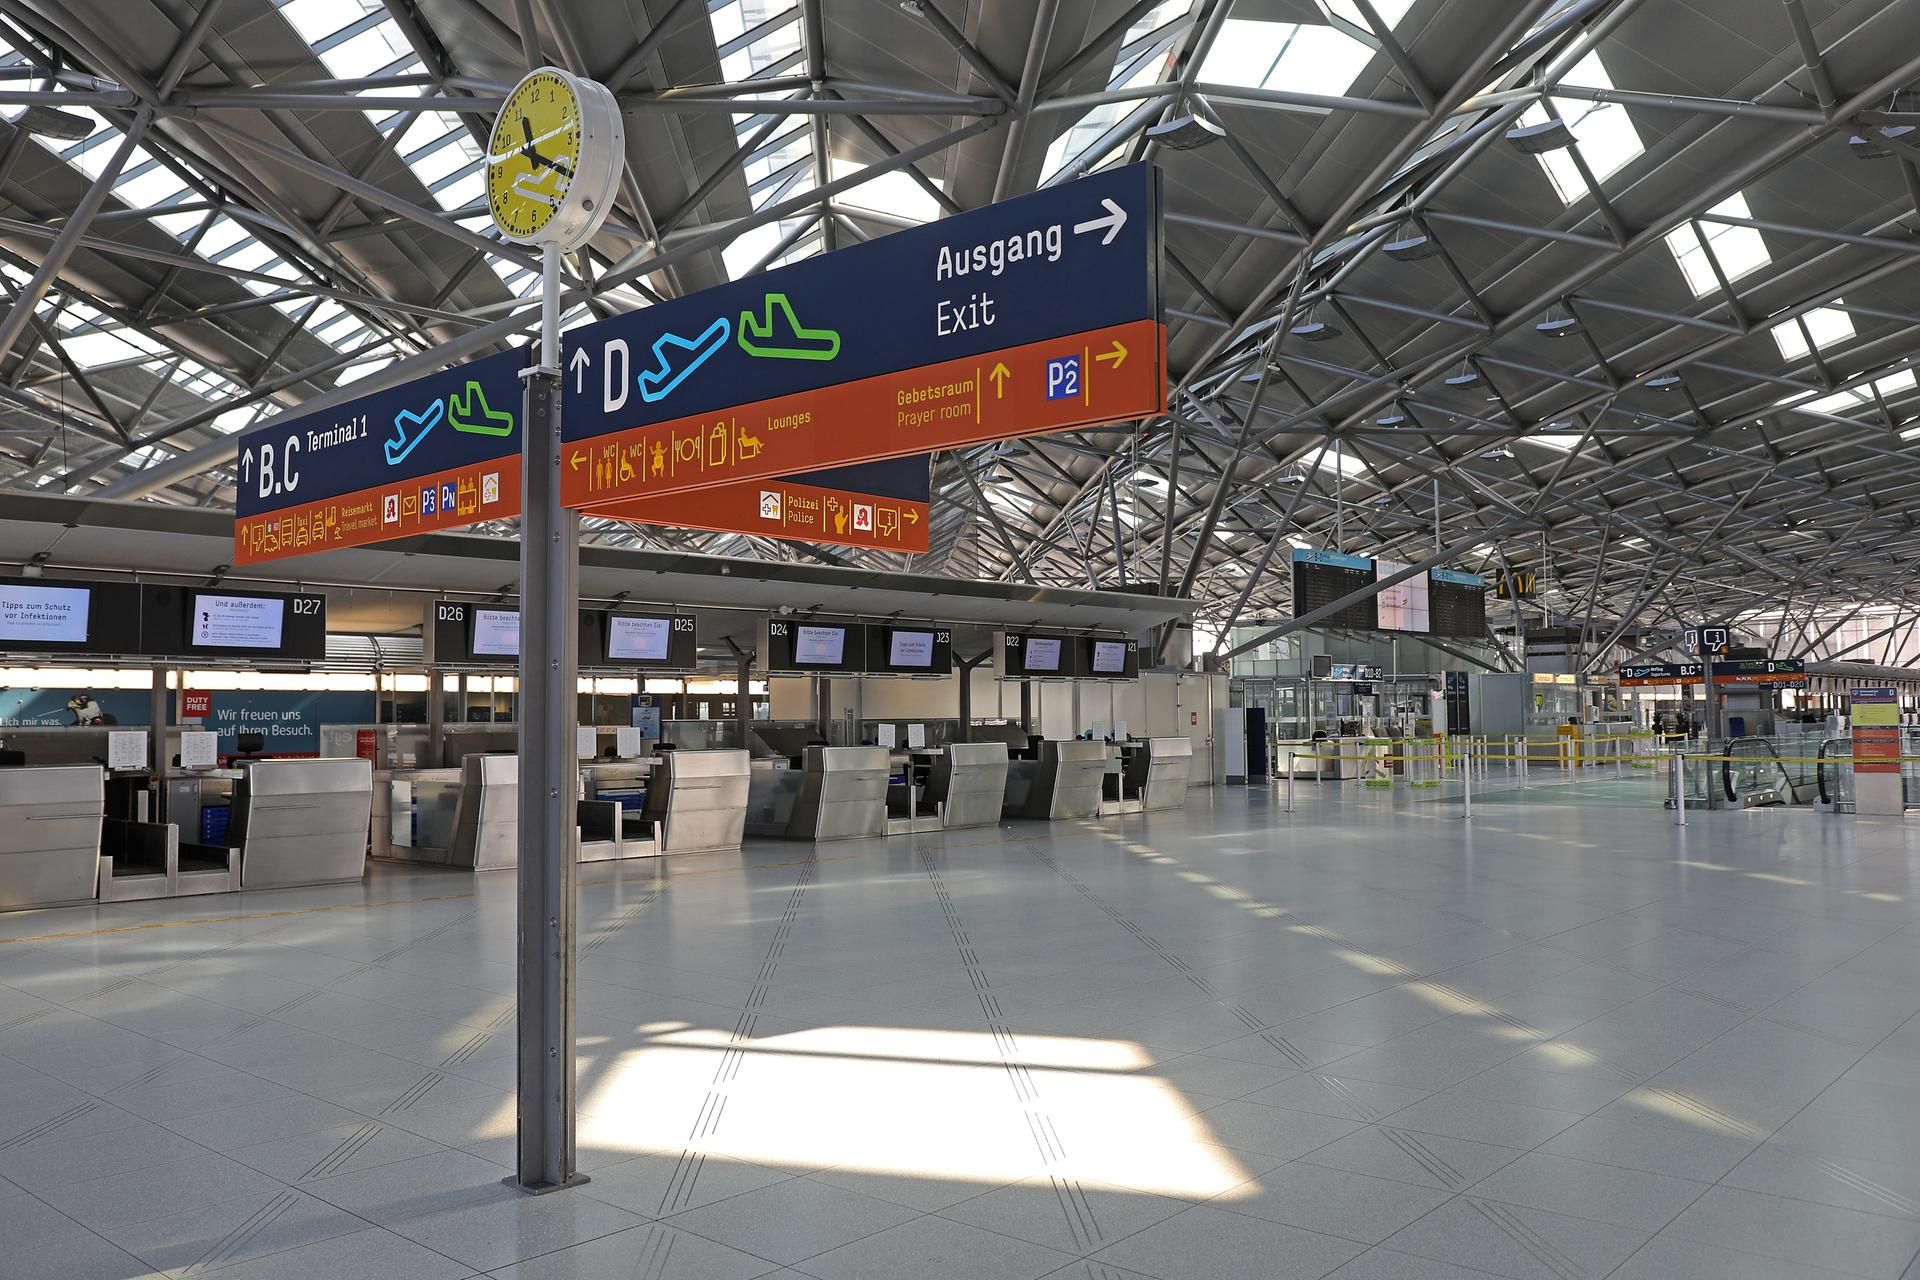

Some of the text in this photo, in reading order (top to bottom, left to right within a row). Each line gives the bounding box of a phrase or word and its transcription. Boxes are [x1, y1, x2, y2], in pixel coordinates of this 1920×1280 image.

[531, 88, 540, 104] 12
[549, 89, 555, 103] 1
[514, 107, 523, 122] 11
[562, 106, 568, 120] 2
[502, 134, 511, 149] 10
[567, 132, 573, 146] 3
[497, 166, 503, 179] 9
[502, 191, 508, 205] 8
[549, 194, 555, 208] 5
[513, 209, 519, 224] 7
[531, 209, 537, 223] 6
[936, 224, 1062, 282] Ausgang
[937, 292, 996, 337] Exit
[604, 338, 630, 413] D
[1048, 359, 1078, 397] P2
[897, 379, 974, 406] Gebetsraum
[768, 411, 811, 430] Lounges
[897, 402, 971, 427] Prayer room
[260, 414, 368, 498] B.C Terminal 1
[603, 445, 616, 458] WC
[629, 443, 642, 457] WC
[422, 489, 436, 513] P3
[788, 495, 819, 510] Polizei
[341, 501, 373, 518] Reisemarkt
[297, 515, 309, 526] Taxi
[342, 516, 377, 531] Travel market
[788, 510, 814, 524] Police
[2, 602, 23, 610] Tipps
[45, 603, 71, 611] Schutz
[215, 600, 265, 609] Und außerdem:
[293, 599, 321, 614] D27
[20, 612, 67, 620] Infektionen
[439, 606, 463, 621] D26
[674, 619, 694, 631] D25
[771, 623, 788, 636] D24
[1006, 636, 1020, 647] D22
[1627, 668, 1633, 677] D
[1680, 666, 1695, 675] B.C
[1768, 662, 1775, 672] D
[1773, 681, 1804, 689] D01-D20
[6, 717, 18, 726] ich
[22, 717, 37, 726] mir
[218, 708, 301, 721] Wir freuen uns
[217, 724, 236, 736] auf
[272, 724, 313, 736] Besuch.
